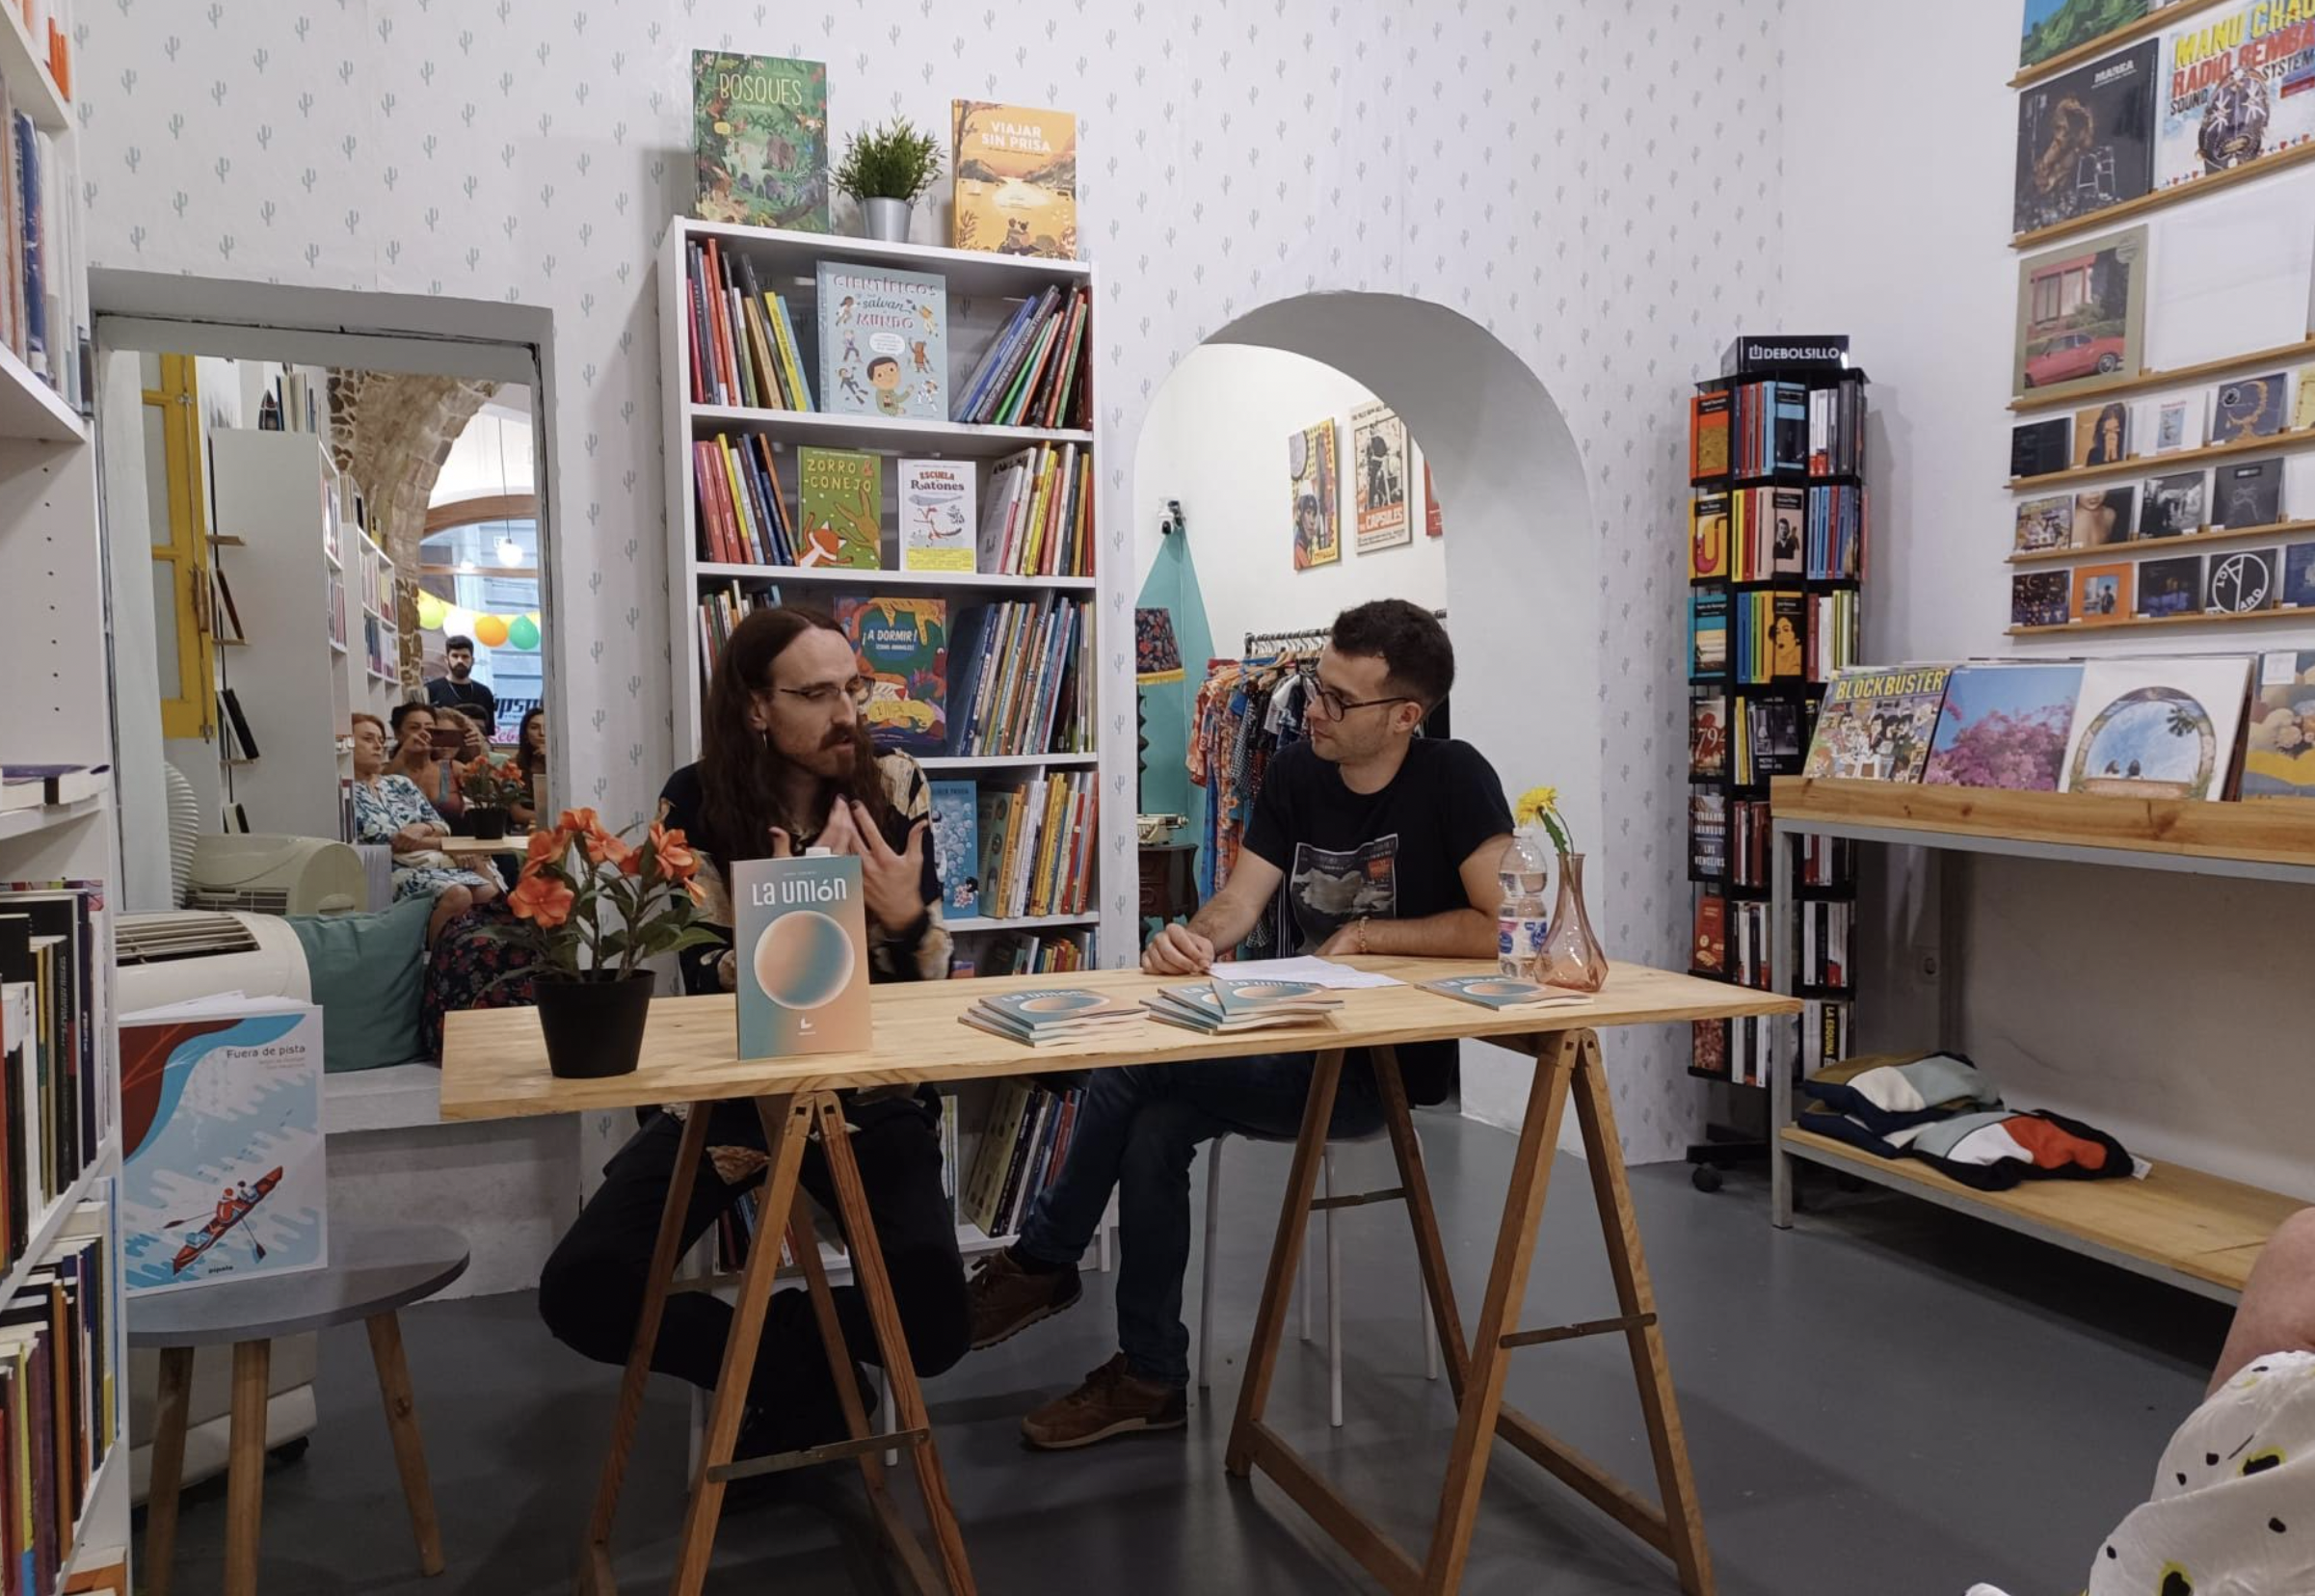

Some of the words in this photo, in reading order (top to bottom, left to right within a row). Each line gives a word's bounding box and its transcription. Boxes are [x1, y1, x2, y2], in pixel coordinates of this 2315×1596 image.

[2175, 11, 2247, 69] MANU
[2172, 50, 2231, 97] RADIO
[719, 72, 802, 106] BOSQUES
[2170, 88, 2209, 117] SOUND
[991, 121, 1042, 138] VIAJAR
[981, 132, 1005, 147] SIN
[1009, 136, 1051, 152] PRISA
[857, 312, 914, 329] MUNDO
[806, 458, 856, 474] ZORRO
[810, 476, 871, 492] CONEJO
[918, 470, 955, 481] ESCUELA
[911, 479, 965, 491] Ratones
[1835, 670, 1947, 702] BLOCKBUSTER
[226, 1049, 258, 1058] Fuera
[262, 1048, 277, 1056] de
[279, 1045, 306, 1056] pista
